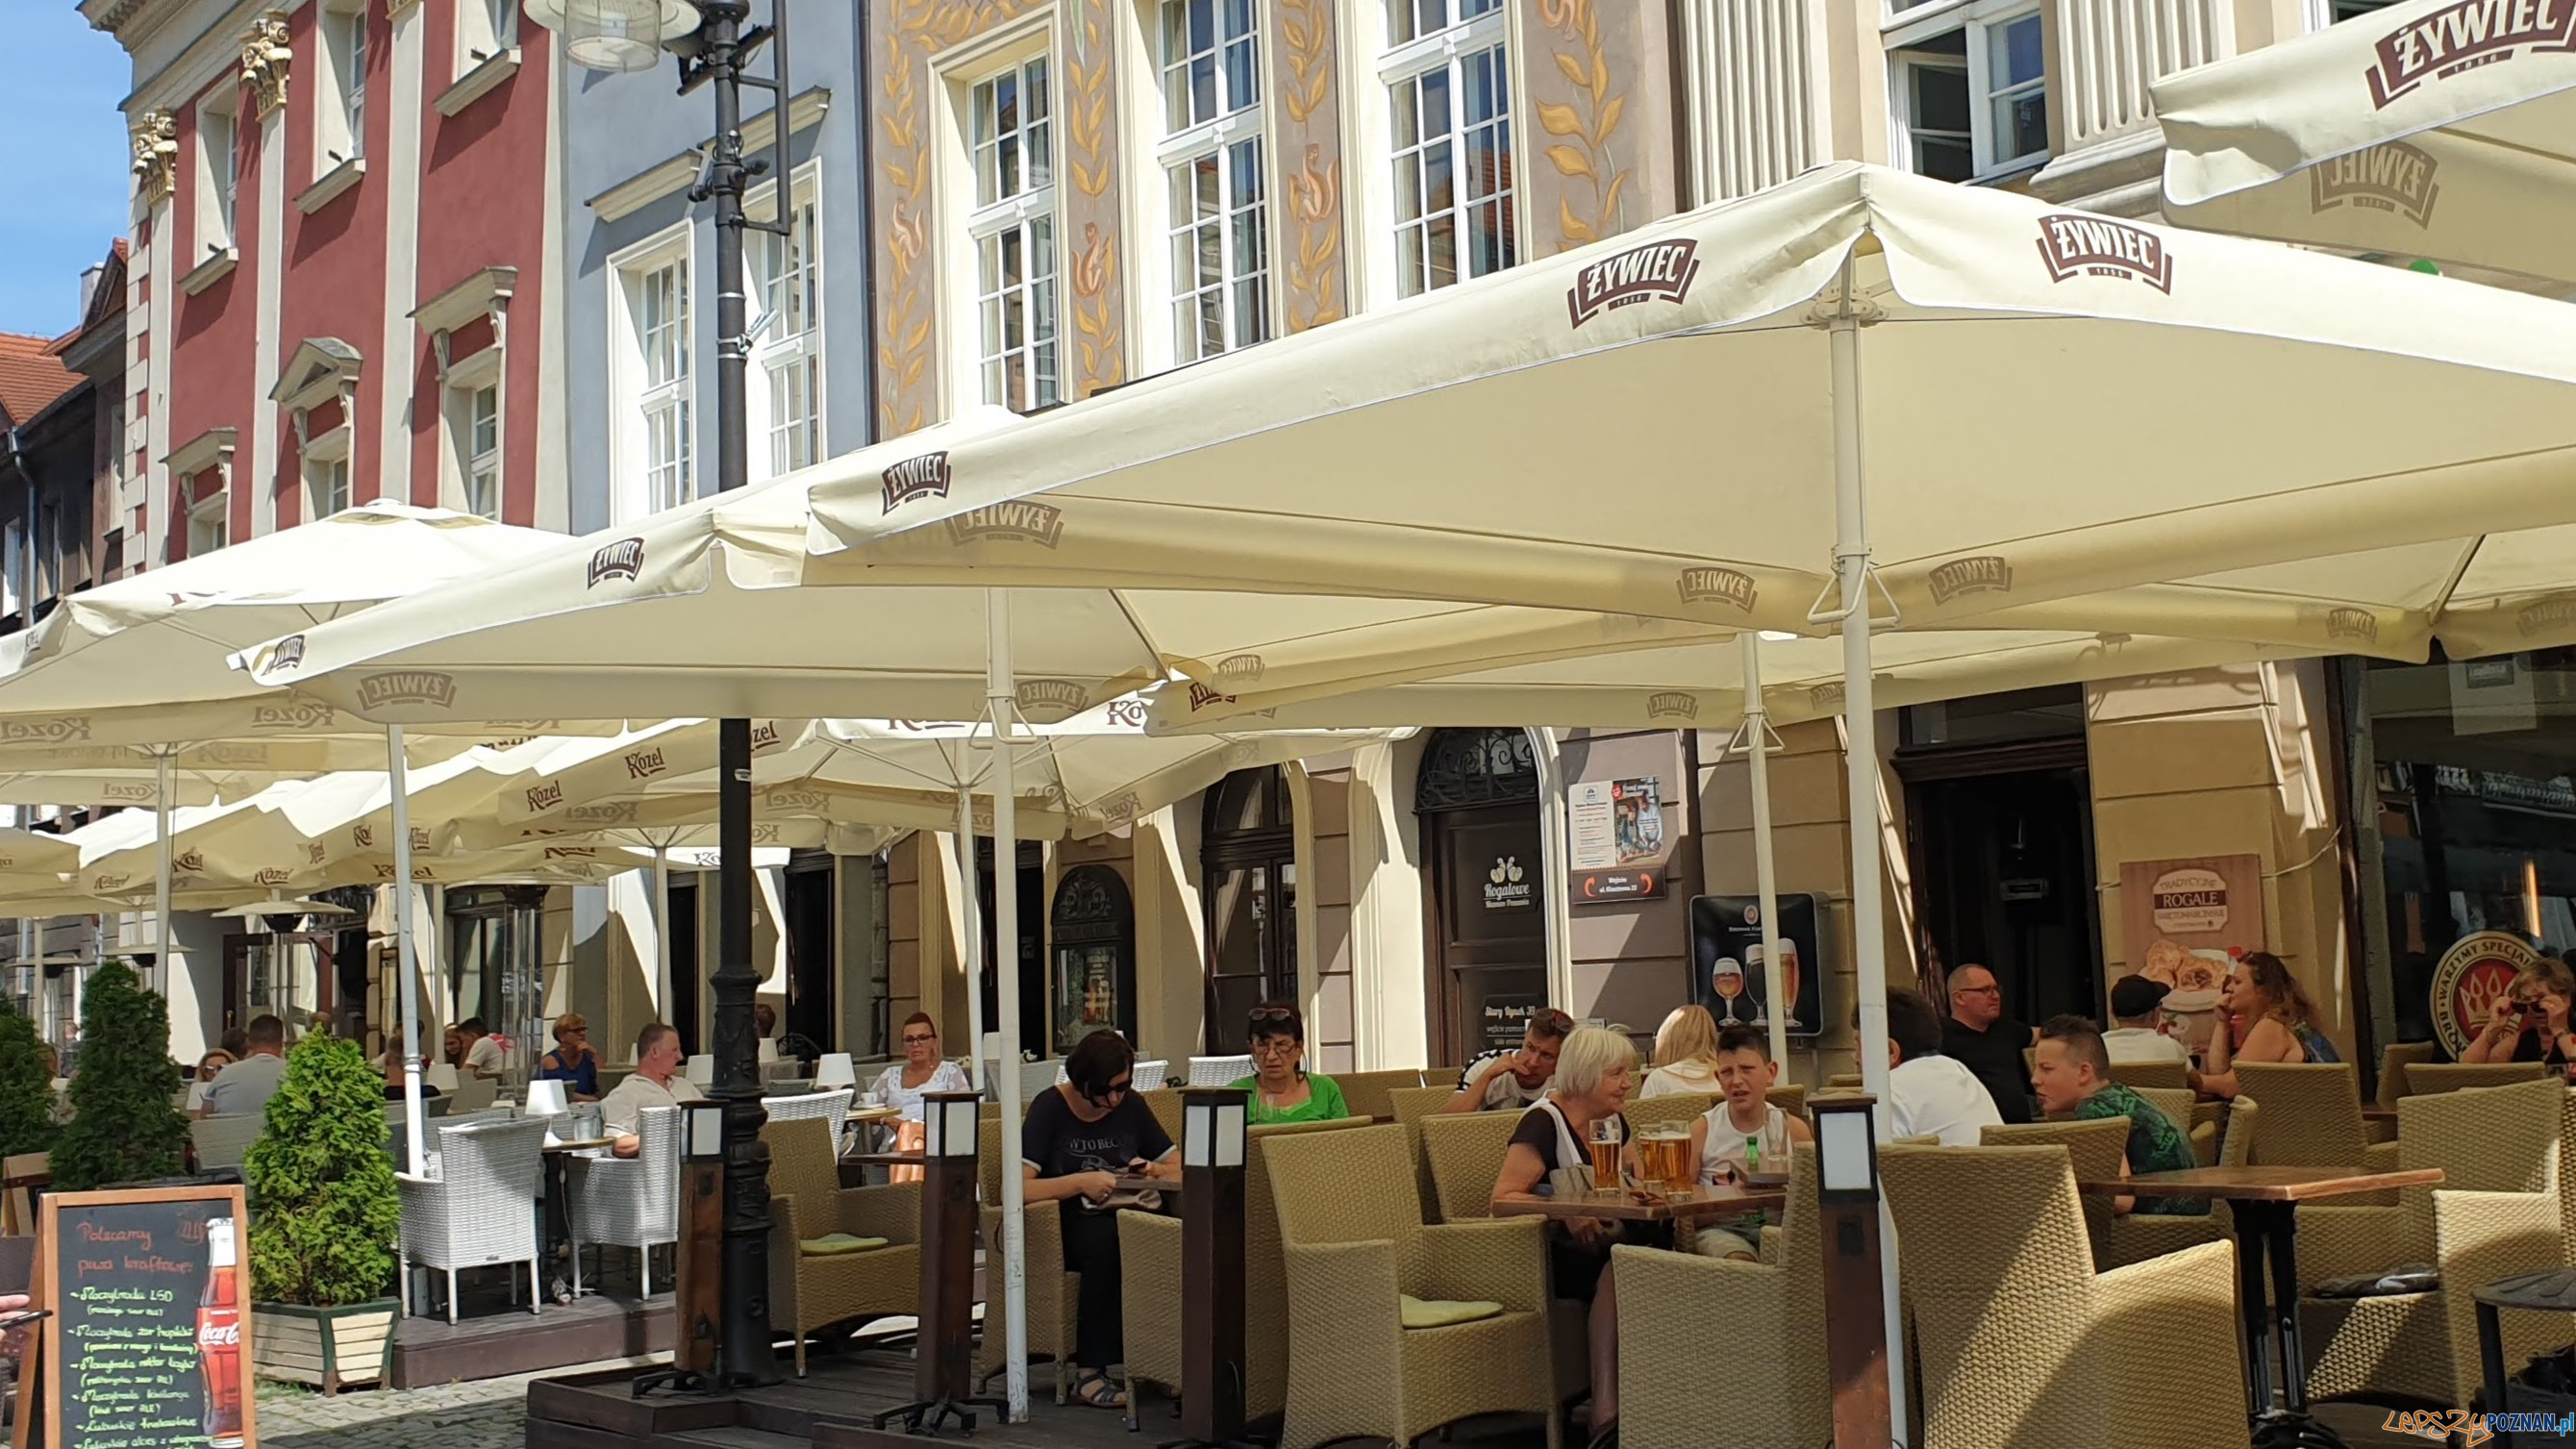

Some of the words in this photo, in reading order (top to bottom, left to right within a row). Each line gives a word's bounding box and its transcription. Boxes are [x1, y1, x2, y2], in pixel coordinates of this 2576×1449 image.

[2392, 0, 2559, 77] ŻYWIEC
[2050, 216, 2154, 269] ŻYWIEC
[1587, 244, 1687, 302] ŻYWIEC
[888, 455, 942, 497] ŻYWIEC
[625, 747, 665, 779] Kozel
[526, 780, 563, 812] Kozel
[1484, 883, 1531, 900] Rogalowe
[2163, 891, 2219, 908] ROGALE
[77, 1221, 152, 1251] Polecamy
